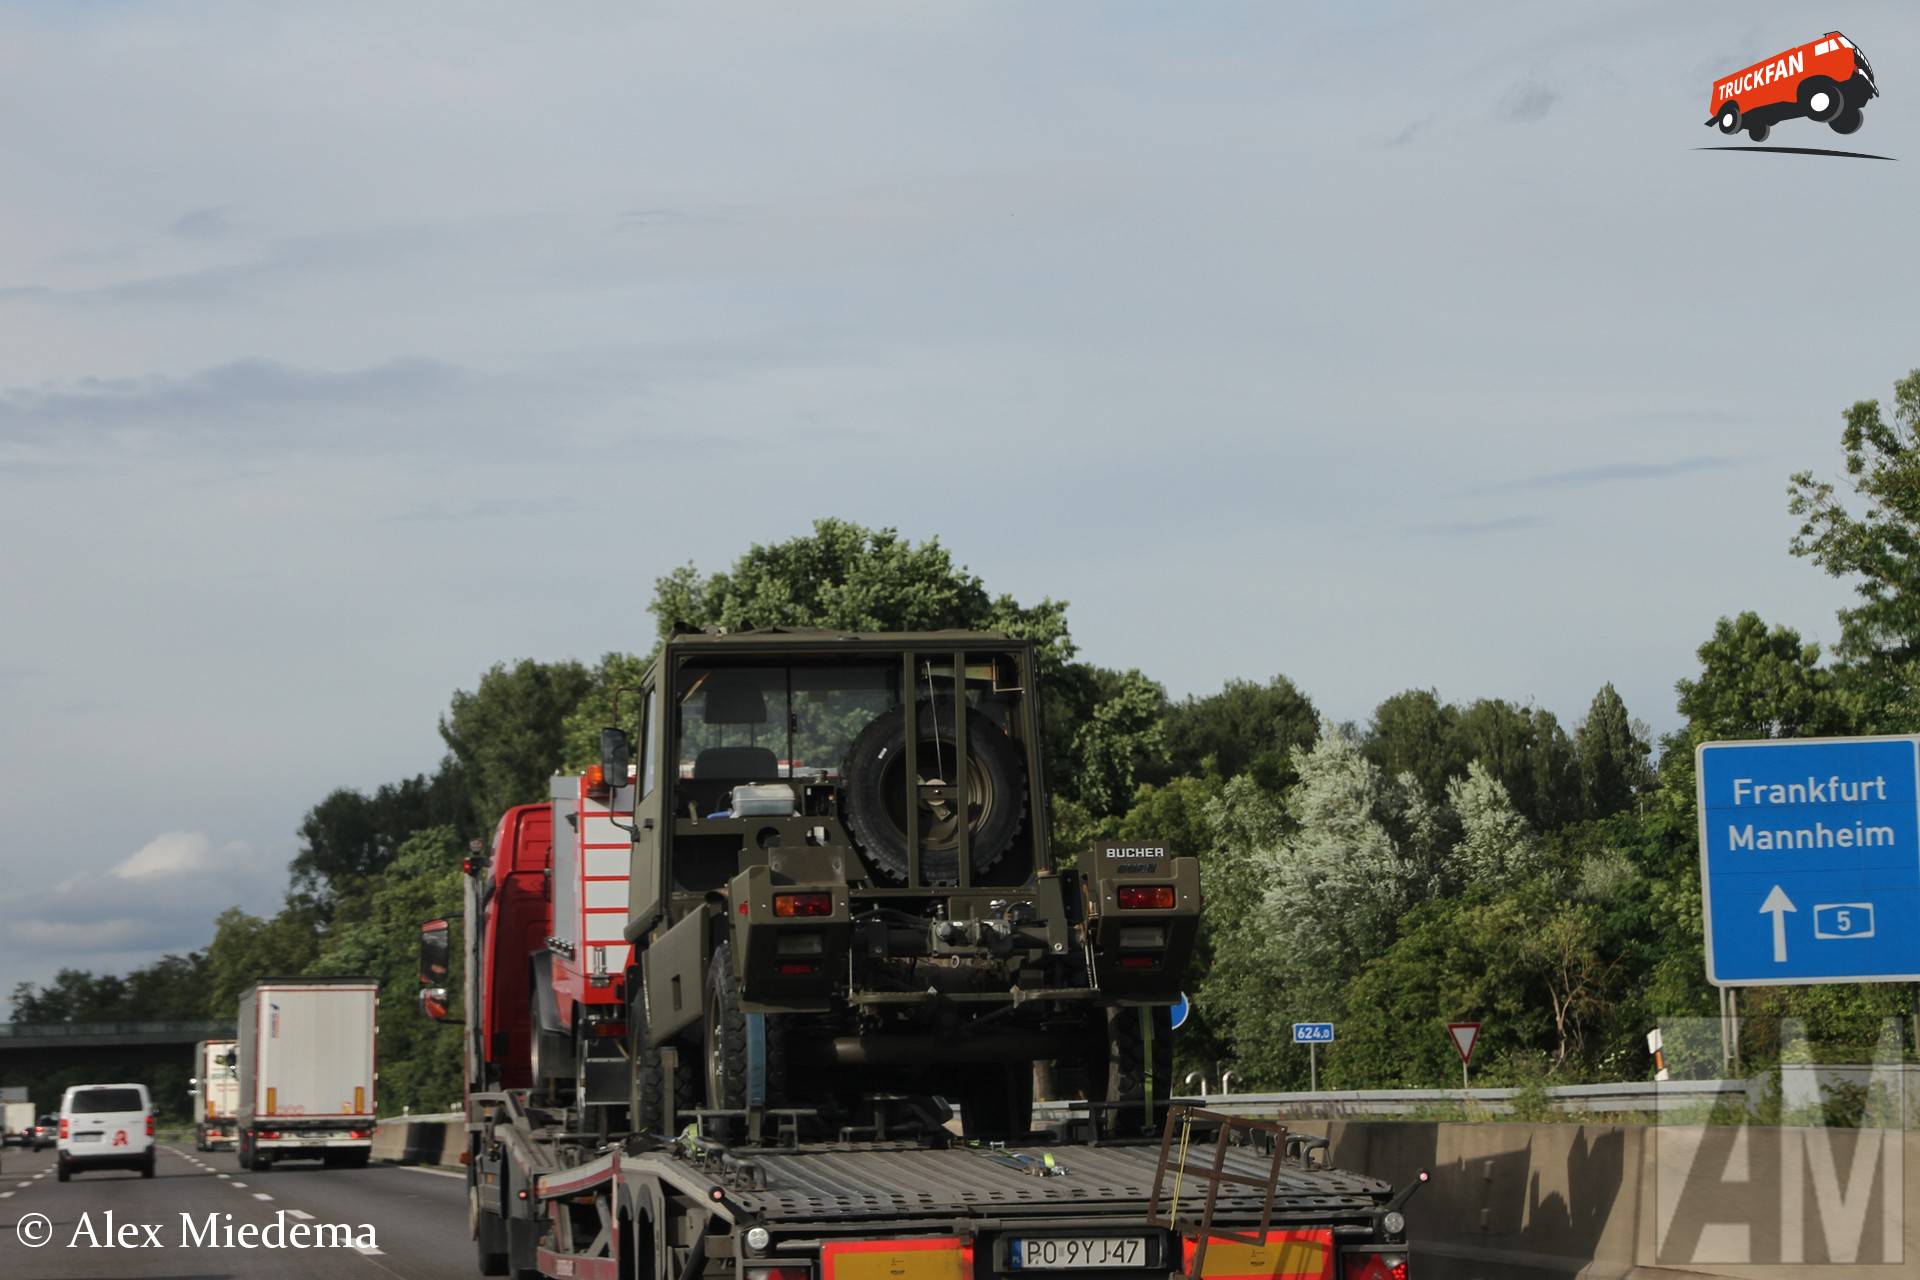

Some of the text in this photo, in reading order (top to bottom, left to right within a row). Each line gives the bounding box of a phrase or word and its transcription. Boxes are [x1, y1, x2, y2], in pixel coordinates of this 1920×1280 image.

[1733, 776, 1887, 805] Frankfurt
[1729, 821, 1895, 851] Mannheim
[1106, 847, 1164, 858] BUCHER
[1836, 911, 1851, 931] 5
